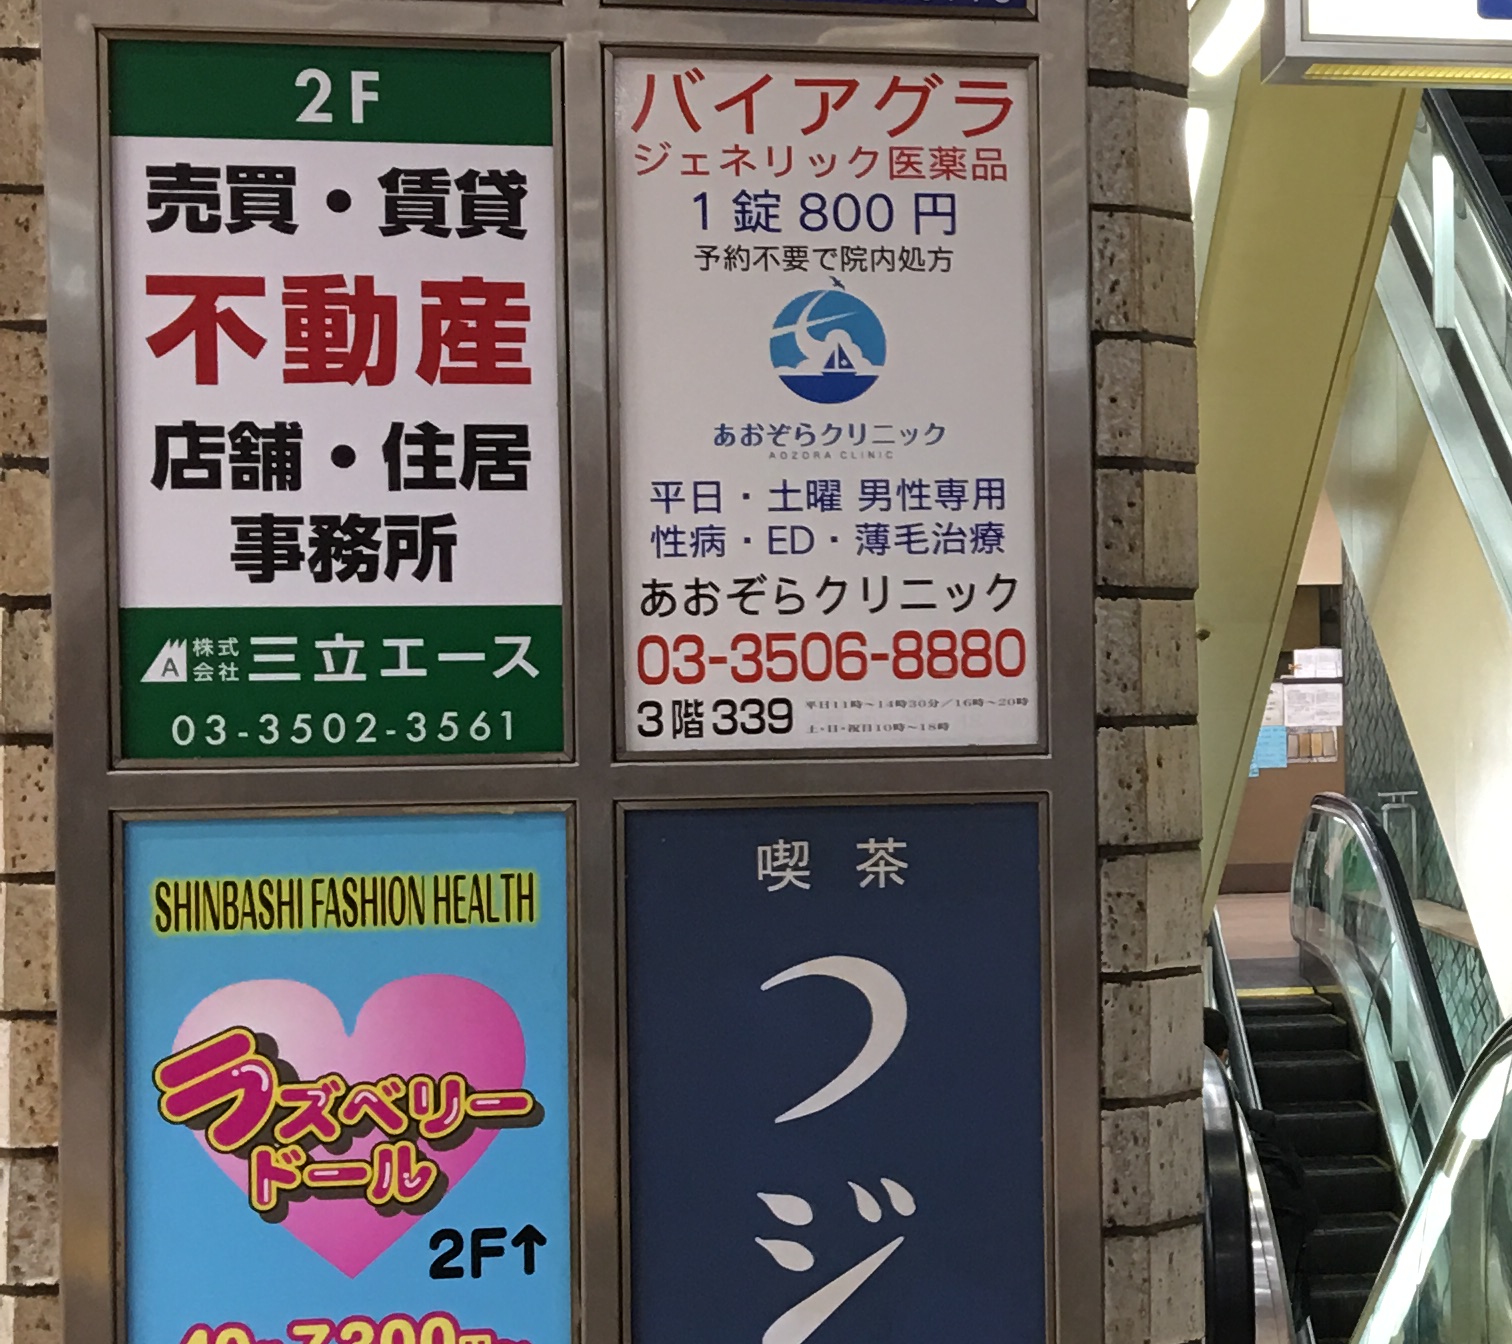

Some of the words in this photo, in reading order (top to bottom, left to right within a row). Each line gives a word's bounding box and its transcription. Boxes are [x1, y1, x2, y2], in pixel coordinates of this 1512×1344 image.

[294, 68, 380, 125] 2F
[630, 66, 1015, 139] バイアグラ
[634, 142, 1008, 182] ジェネリック医薬品
[145, 163, 528, 240] 売買・賃貸
[694, 243, 954, 274] 予約不要で院内処方
[145, 274, 532, 386] 不動産
[149, 420, 531, 492] 店舗・住居
[713, 422, 946, 448] あおぞらクリニック
[768, 451, 832, 461] AOZORA
[839, 450, 894, 460] CLINIC
[649, 479, 843, 515] 平日・土曜
[857, 477, 1007, 513] 男性専用
[230, 512, 457, 584] 事務所
[650, 522, 1007, 560] 性病・ED・薄毛治療
[640, 571, 1019, 618] あおぞらクリニック
[191, 636, 240, 657] 株式
[192, 660, 240, 682] 会社
[247, 633, 540, 683] 三立エース
[636, 627, 1027, 686] 03-3506-8880
[171, 709, 515, 746] 03-3502-3561
[636, 696, 795, 740] 3階339
[756, 836, 910, 893] 喫茶
[154, 877, 305, 934] SHINBASHI
[310, 875, 428, 930] FASHION
[432, 871, 536, 926] HEALTH
[152, 1025, 538, 1154] ラズベリー
[246, 1140, 441, 1213] ドール
[429, 1227, 507, 1280] 2F
